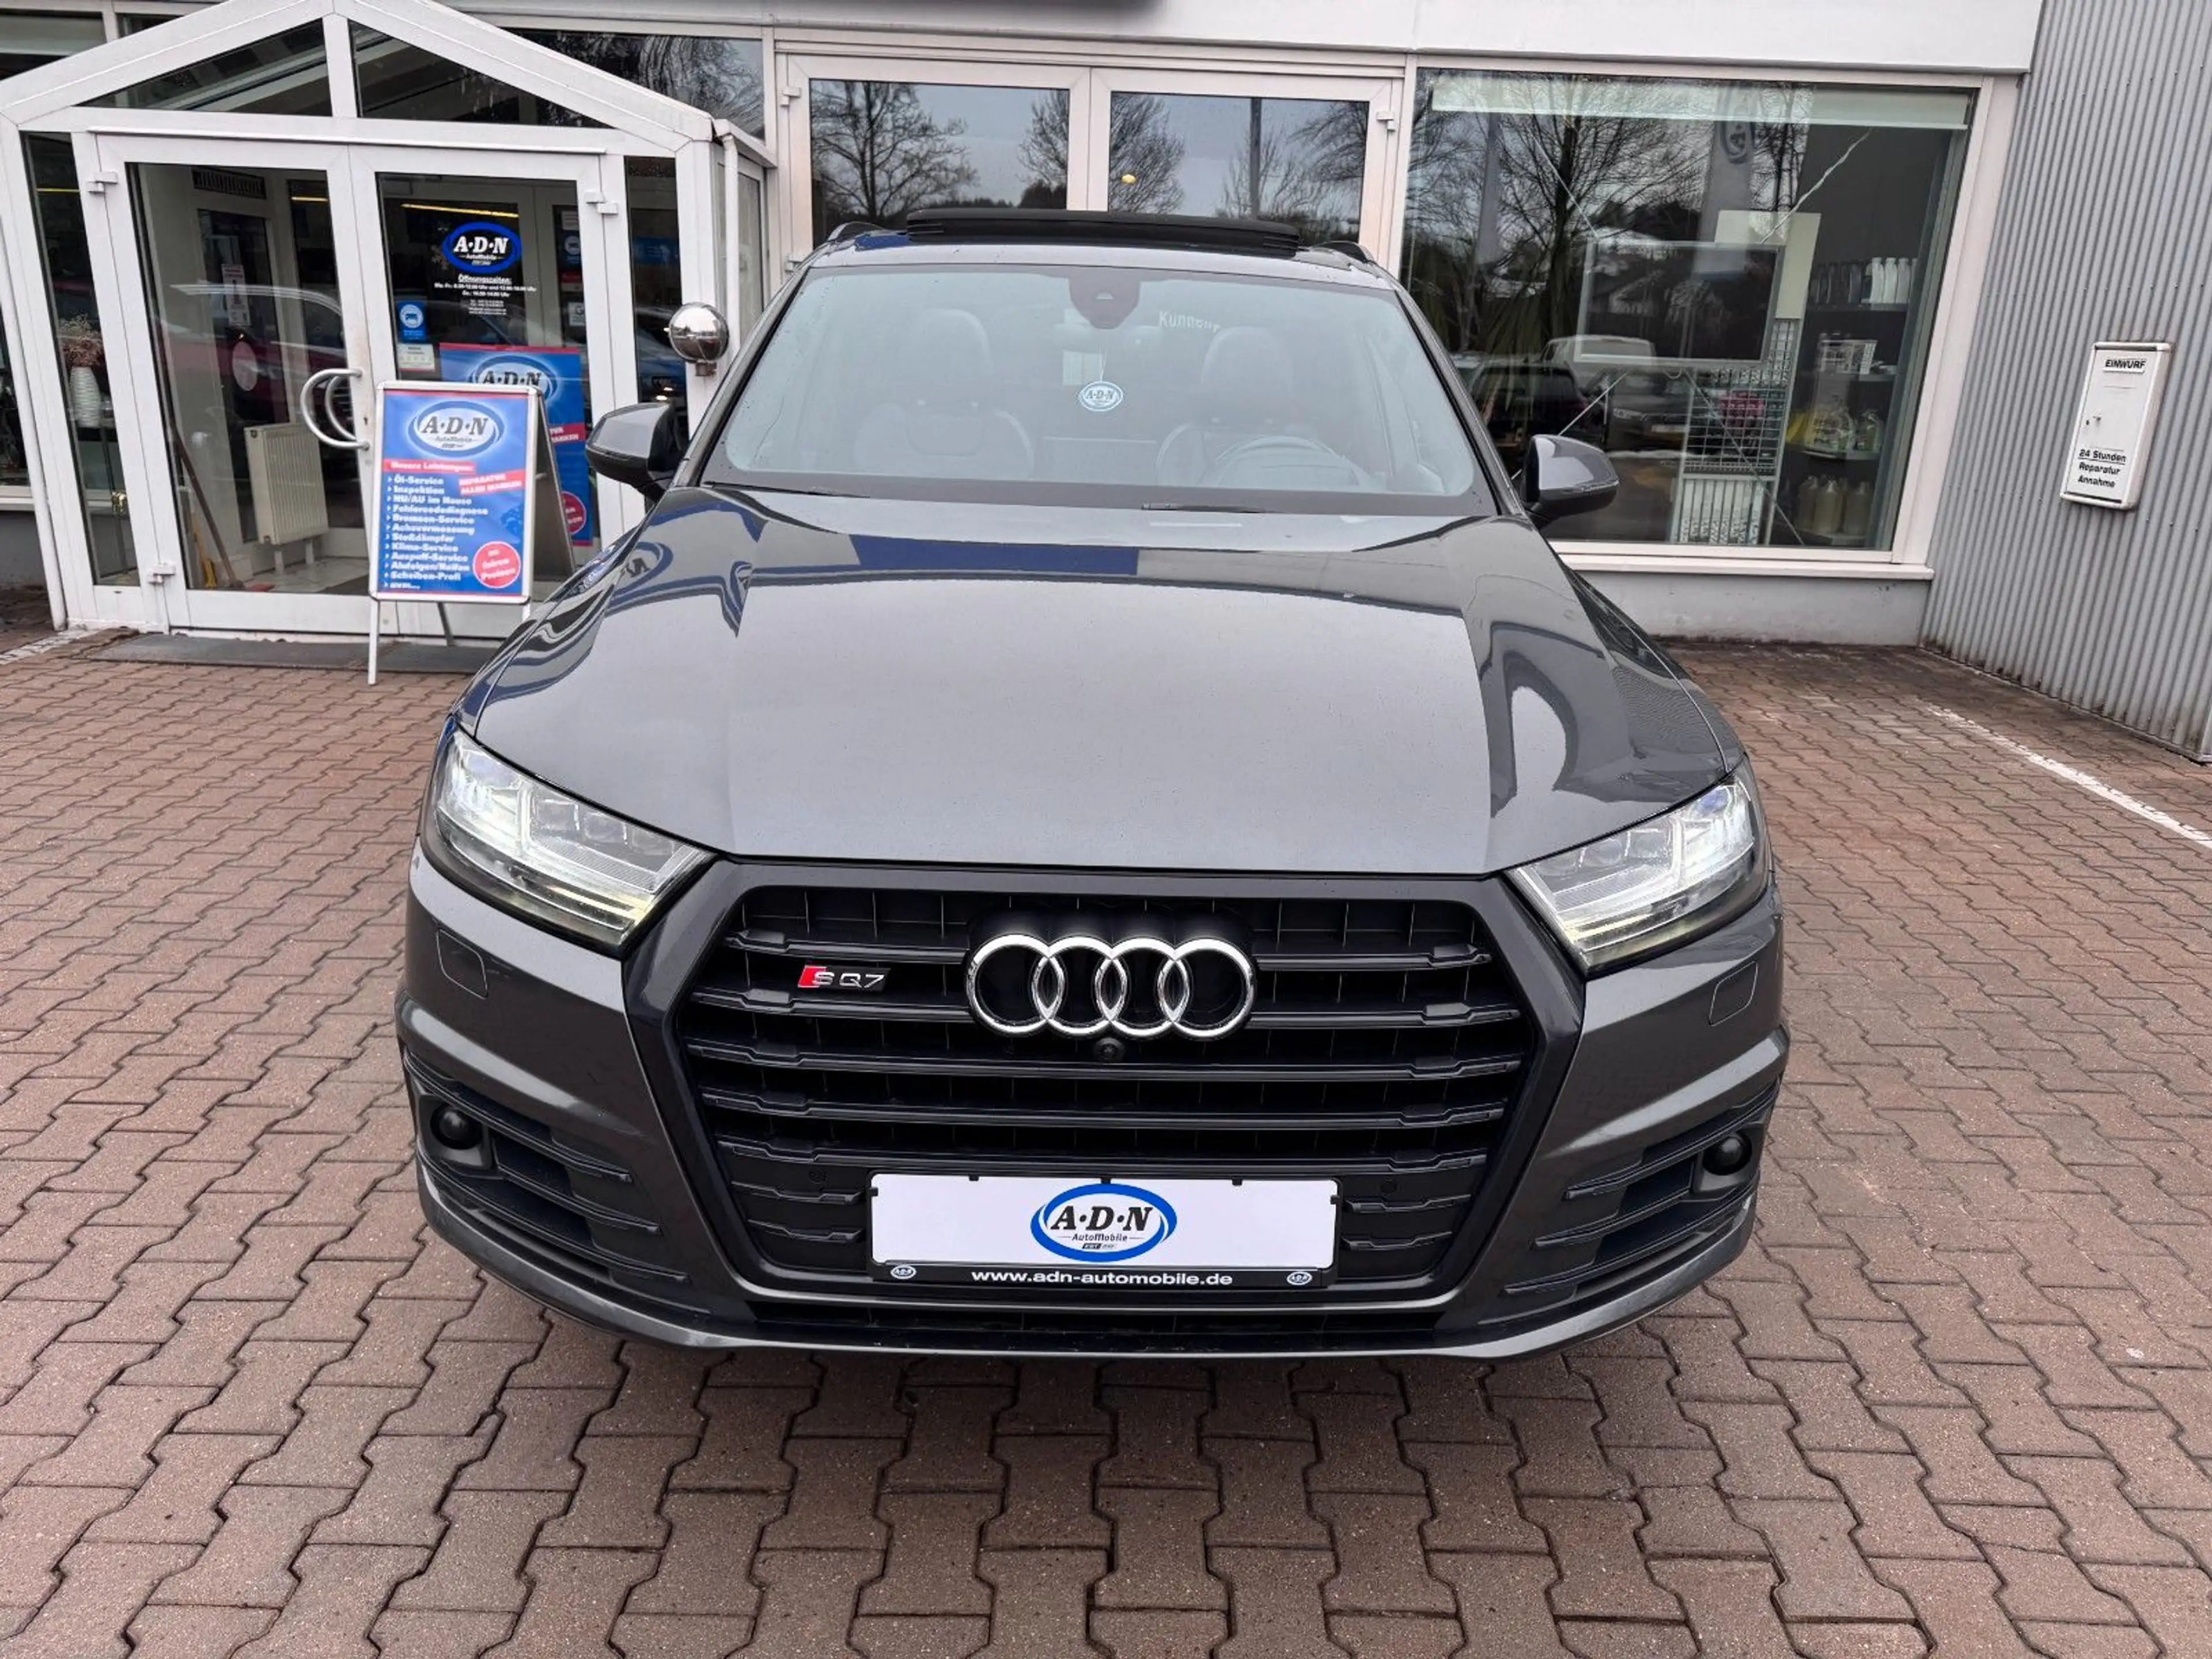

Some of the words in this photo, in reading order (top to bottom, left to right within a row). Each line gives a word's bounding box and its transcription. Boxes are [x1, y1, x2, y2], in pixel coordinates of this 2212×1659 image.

[2105, 358, 2146, 369] EINWURF
[2079, 449, 2090, 457] 24
[2093, 450, 2126, 462] Stunden
[2079, 461, 2120, 475] Reparatur
[394, 475, 444, 485] Öl-Service
[2078, 475, 2115, 488] Annahme
[393, 485, 445, 495] Inspektion
[442, 496, 472, 505] Hause
[392, 514, 475, 524] Bremsen-Service
[392, 524, 475, 535] Achsvermessung
[392, 543, 459, 552] Klima-Service
[813, 972, 885, 988] SQ7
[971, 1270, 1233, 1286] www.adn-automobile.de
